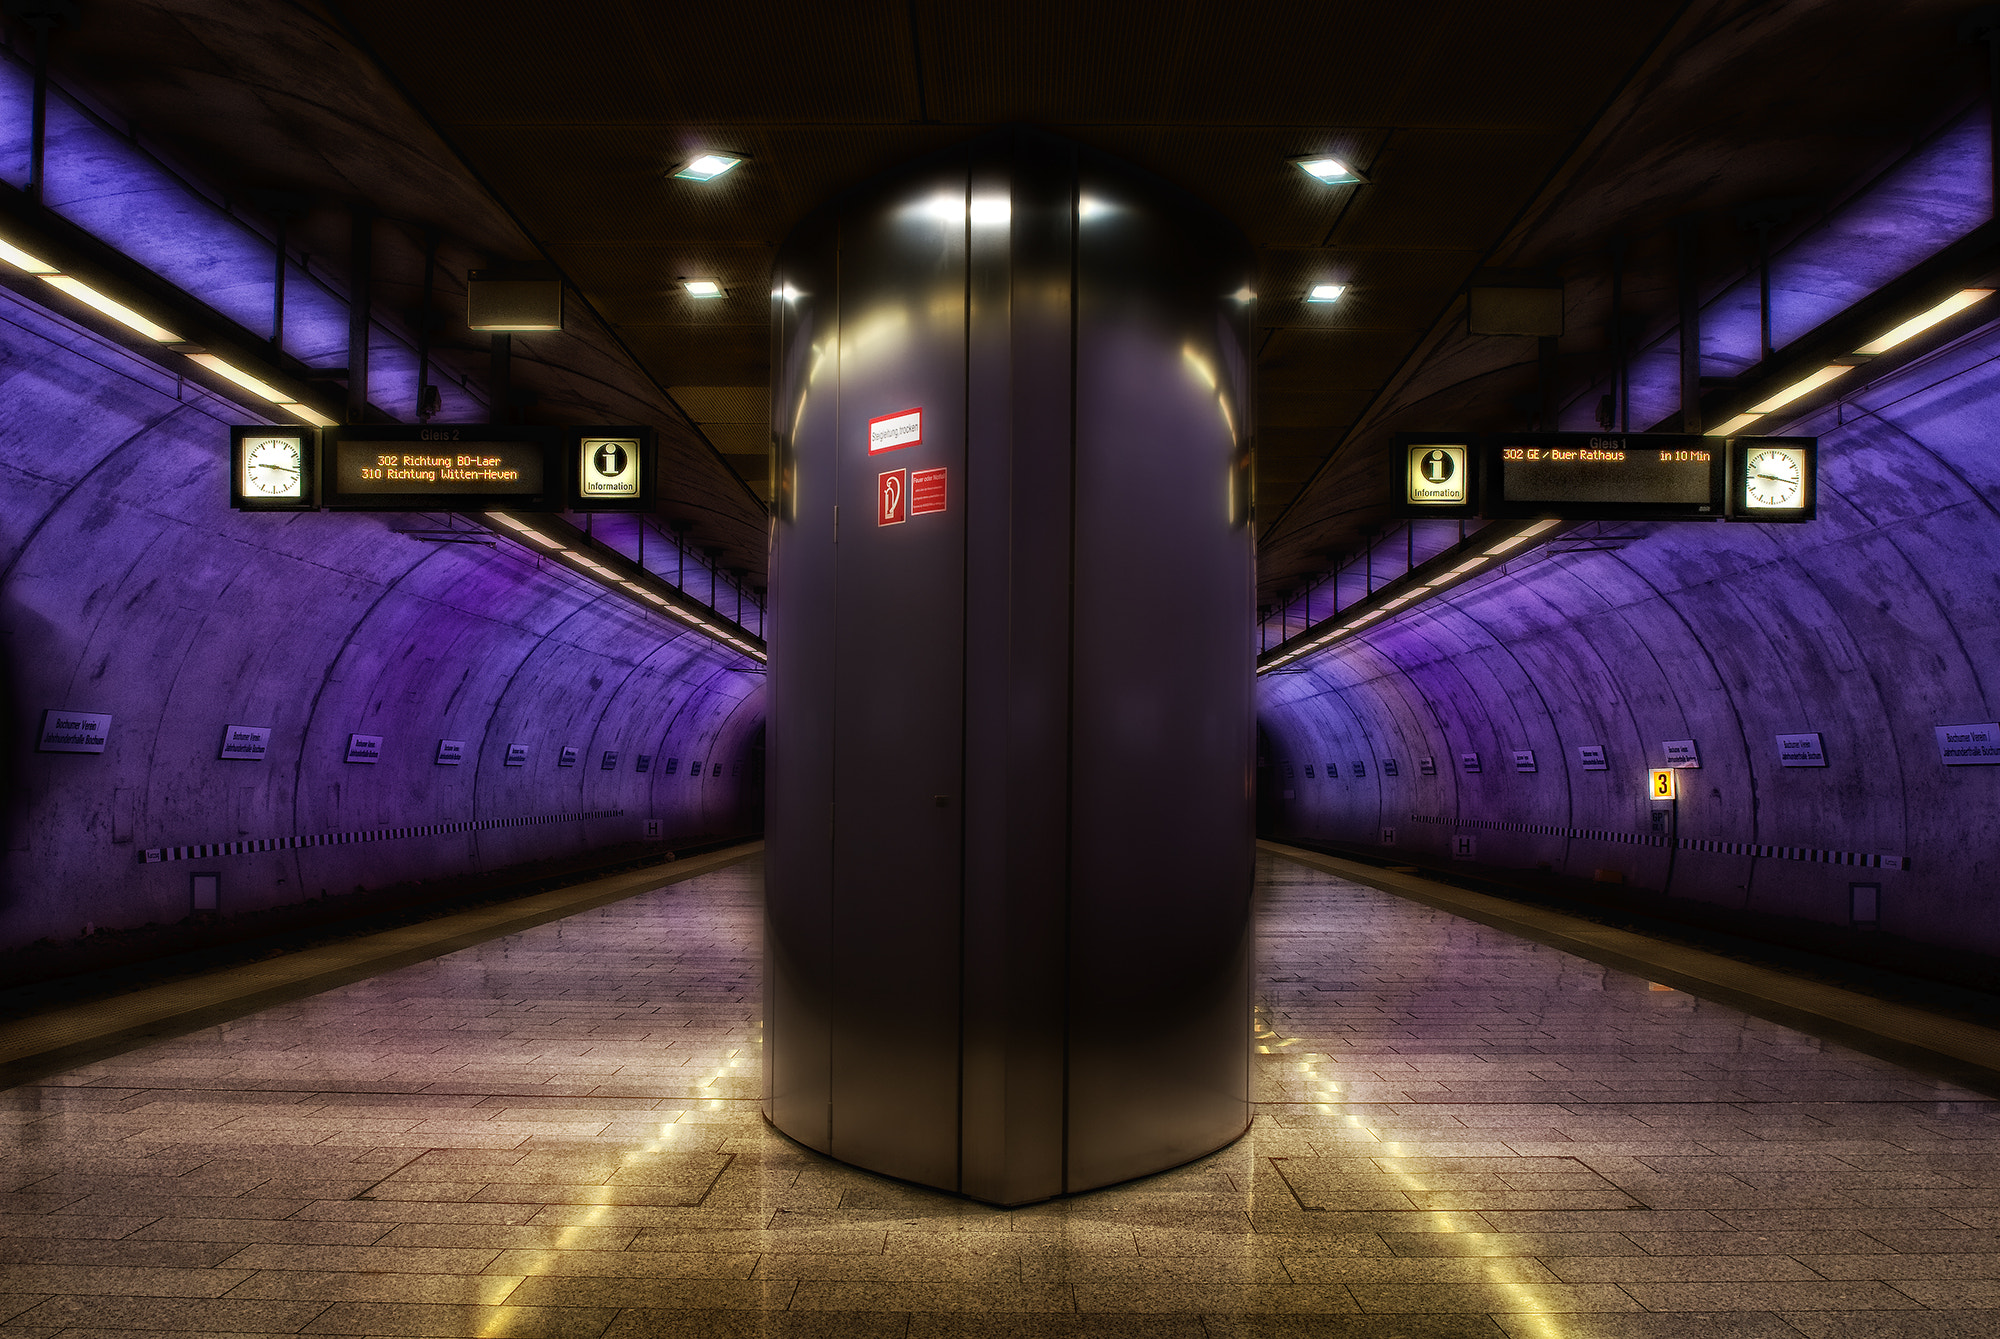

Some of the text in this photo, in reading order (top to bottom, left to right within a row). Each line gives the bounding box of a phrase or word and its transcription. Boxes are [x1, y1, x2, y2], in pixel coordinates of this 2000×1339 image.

[420, 429, 460, 441] Gleis 2
[1589, 437, 1627, 449] Gleis 1
[377, 455, 501, 468] 302 Richtung BO-Laer
[1503, 449, 1711, 461] 302 GE / Buer Rathaus in 10 Min
[361, 468, 518, 482] 310 Richtung Witten-Heven
[588, 481, 633, 491] Information
[1414, 488, 1460, 497] Information
[55, 718, 81, 730] Bochumer
[81, 720, 97, 731] Verein
[84, 734, 105, 745] Bochum
[1658, 773, 1668, 794] 3
[649, 822, 658, 835] H
[1384, 830, 1393, 843] H
[1459, 838, 1470, 853] H
